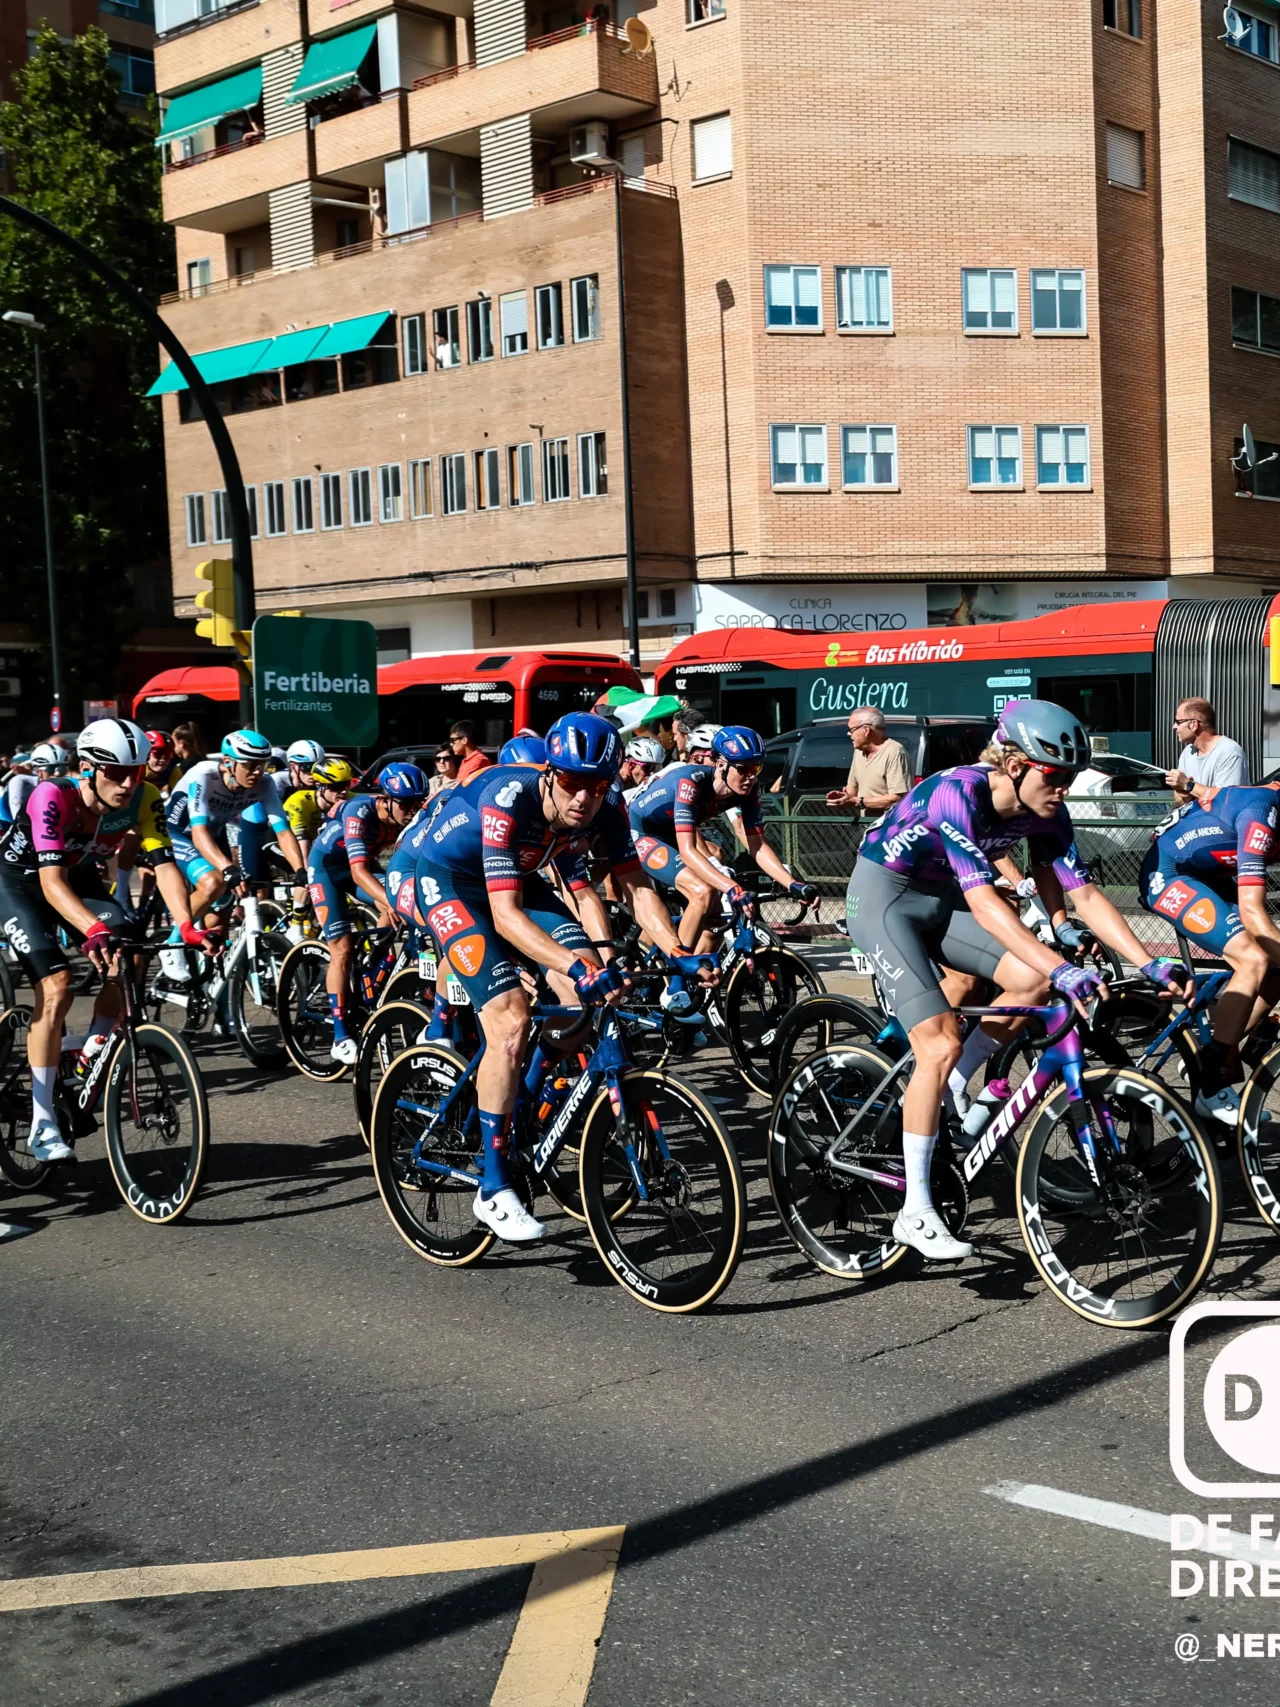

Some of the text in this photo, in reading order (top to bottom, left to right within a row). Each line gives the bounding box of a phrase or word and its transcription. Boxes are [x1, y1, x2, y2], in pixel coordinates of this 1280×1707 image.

[1081, 591, 1112, 599] INTEGRAL
[865, 644, 897, 664] Bus
[897, 639, 964, 662] Híbrido
[675, 666, 709, 675] HYBRID
[263, 671, 371, 694] Fertiberia
[809, 676, 909, 711] Gustera
[264, 698, 333, 712] Fertilizantes
[167, 796, 188, 825] BAHRAIN
[483, 814, 509, 832] PIC
[881, 822, 930, 863] Jayco
[940, 821, 990, 864] GIAN
[1182, 826, 1224, 845] HANS ANDERS
[1252, 828, 1273, 844] PIC
[1166, 886, 1188, 904] PIC
[436, 905, 463, 931] PIC
[422, 962, 436, 978] 191
[453, 944, 477, 973] postnl
[856, 956, 868, 972] 74
[452, 983, 466, 1002] 196
[410, 1057, 457, 1077] URSUS
[534, 1069, 592, 1174] LAPIERRE
[963, 1063, 1039, 1183] GIANT
[1081, 1142, 1101, 1188] GIANT
[450, 1170, 479, 1186] SHIMANO
[1023, 1195, 1116, 1316] CADEX
[607, 1248, 659, 1300] URSUS
